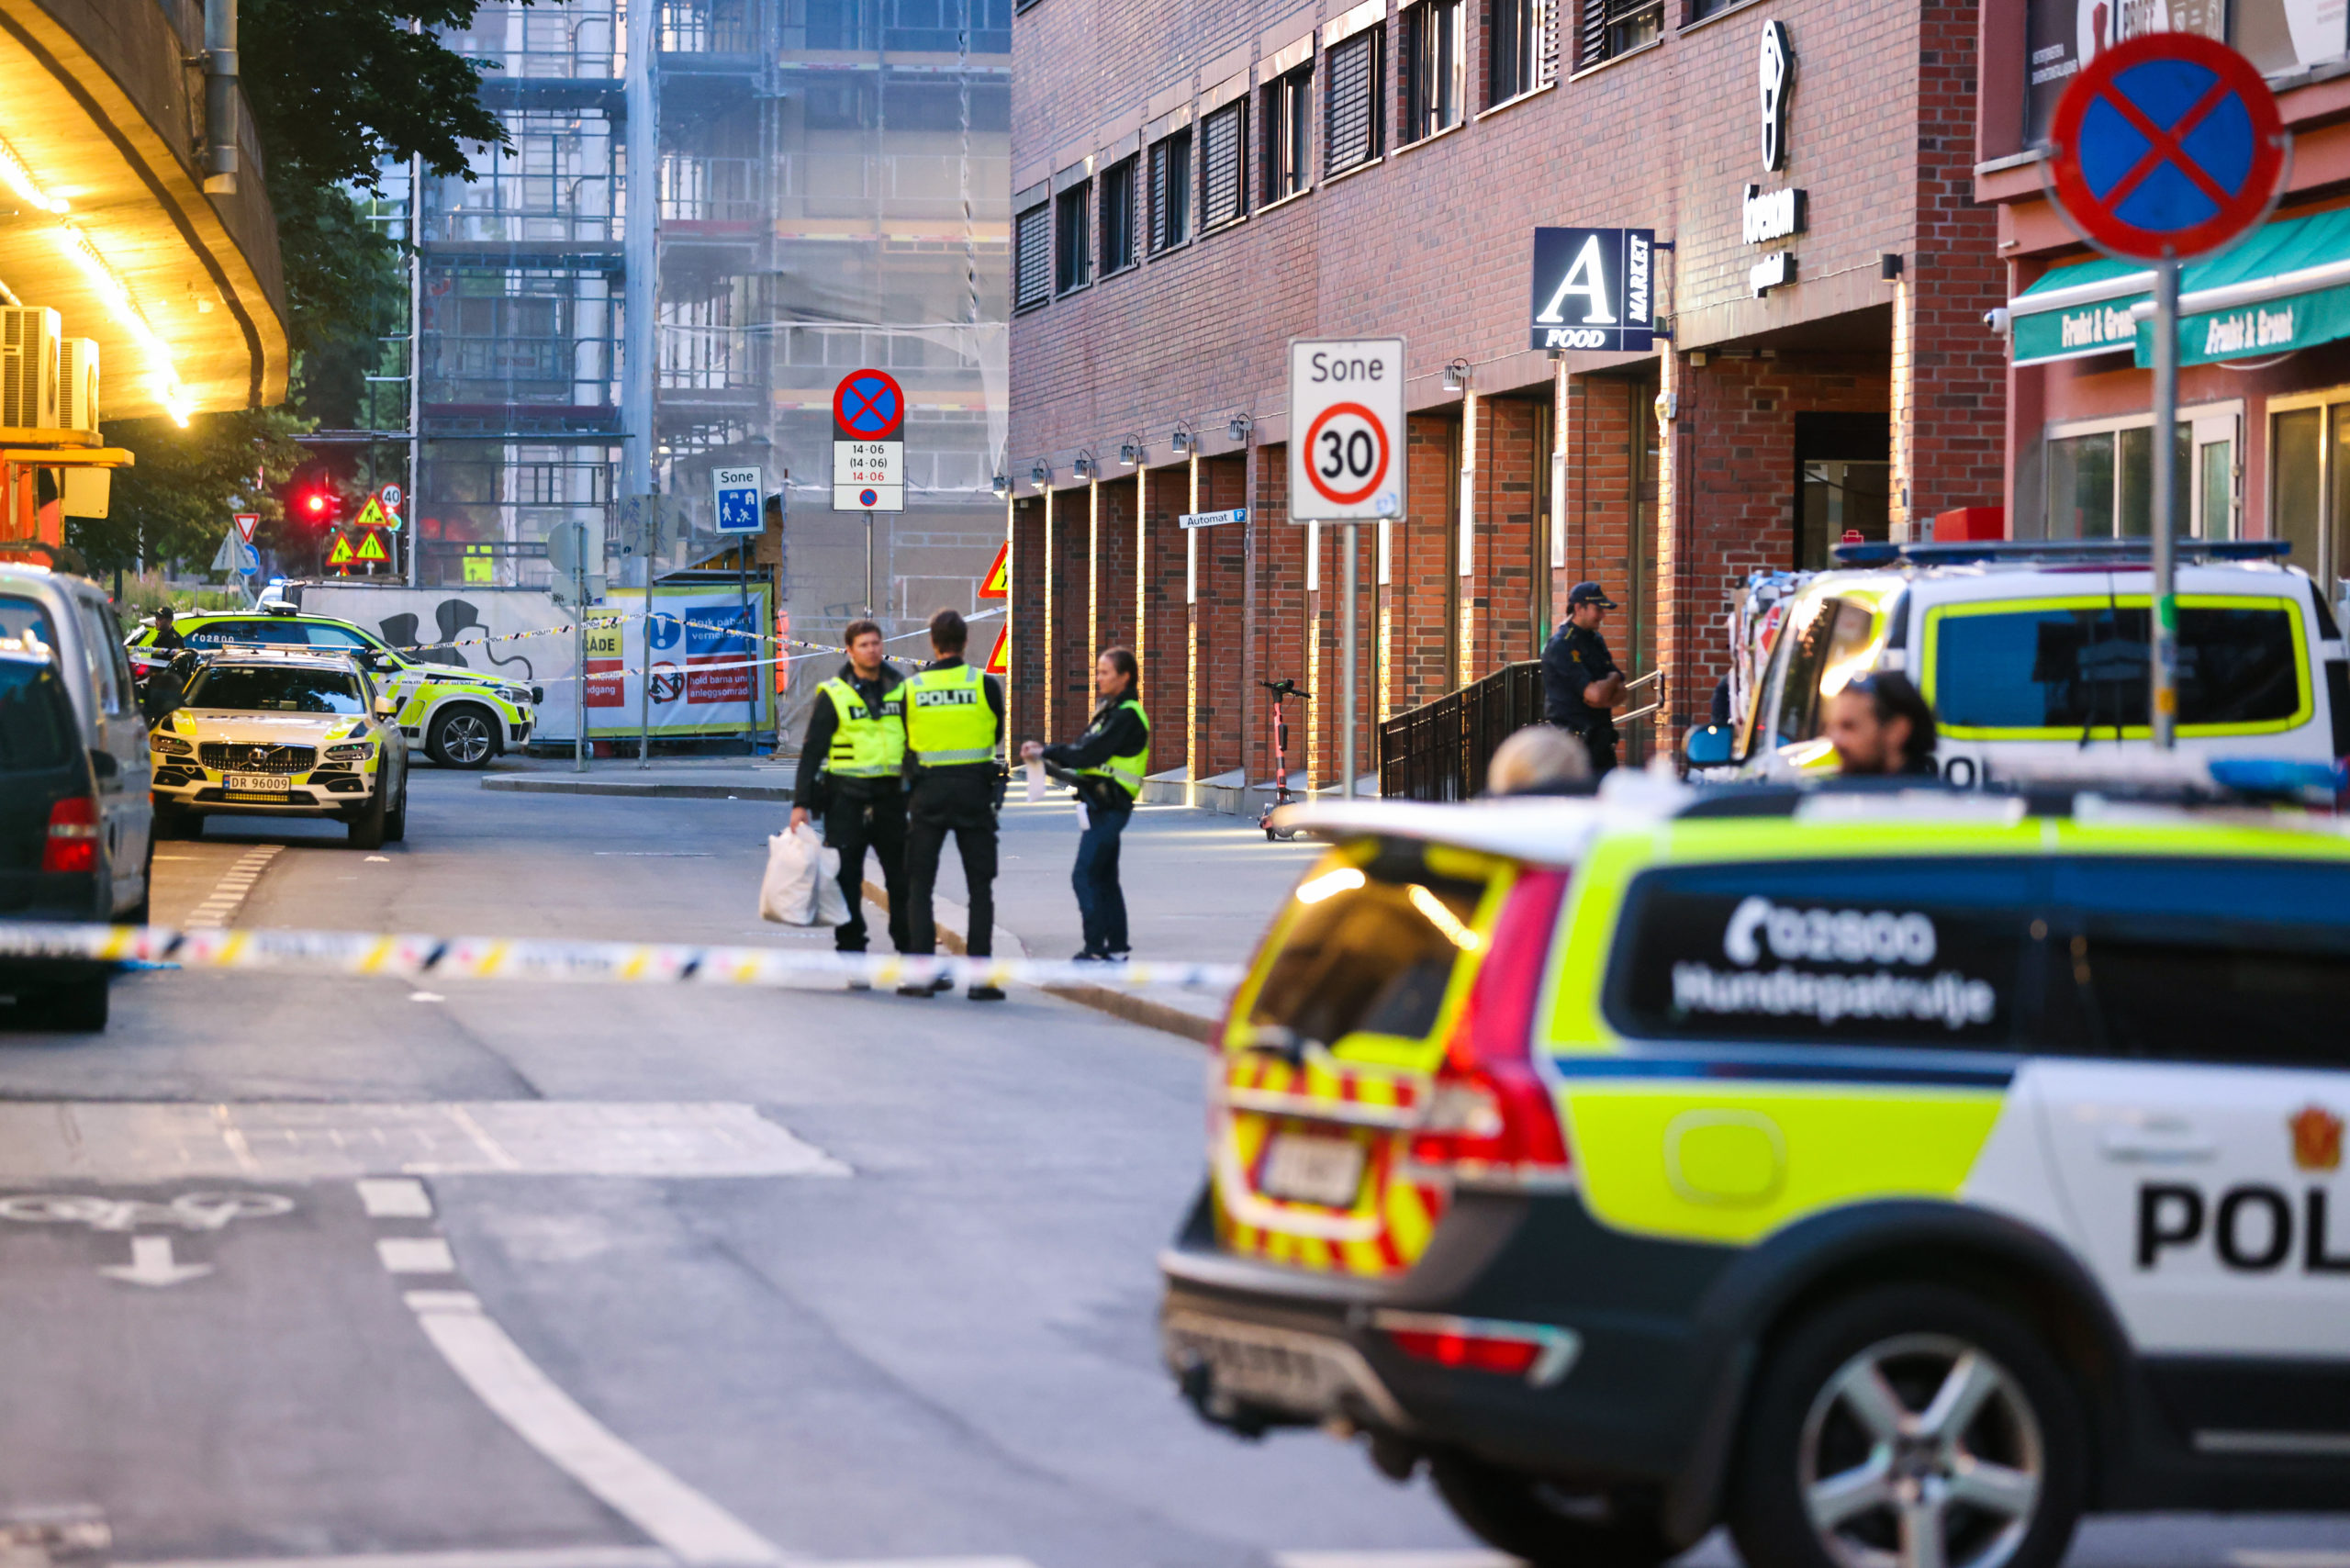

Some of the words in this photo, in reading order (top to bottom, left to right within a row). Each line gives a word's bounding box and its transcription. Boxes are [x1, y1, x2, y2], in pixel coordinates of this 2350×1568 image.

[1536, 234, 1617, 323] A
[1628, 234, 1649, 323] MARKET
[1545, 329, 1606, 348] FOOD
[1312, 352, 1383, 383] Sone
[853, 444, 885, 454] 14-06
[1320, 429, 1373, 479] 30
[721, 471, 754, 483] Sone
[853, 471, 885, 482] 14-06
[385, 489, 400, 503] 40
[1187, 513, 1228, 526] Automat
[689, 687, 753, 700] anleggsområd
[916, 689, 977, 707] POLITI
[231, 778, 247, 789] DR
[252, 778, 287, 790] 96009
[2135, 1180, 2350, 1274] POL
